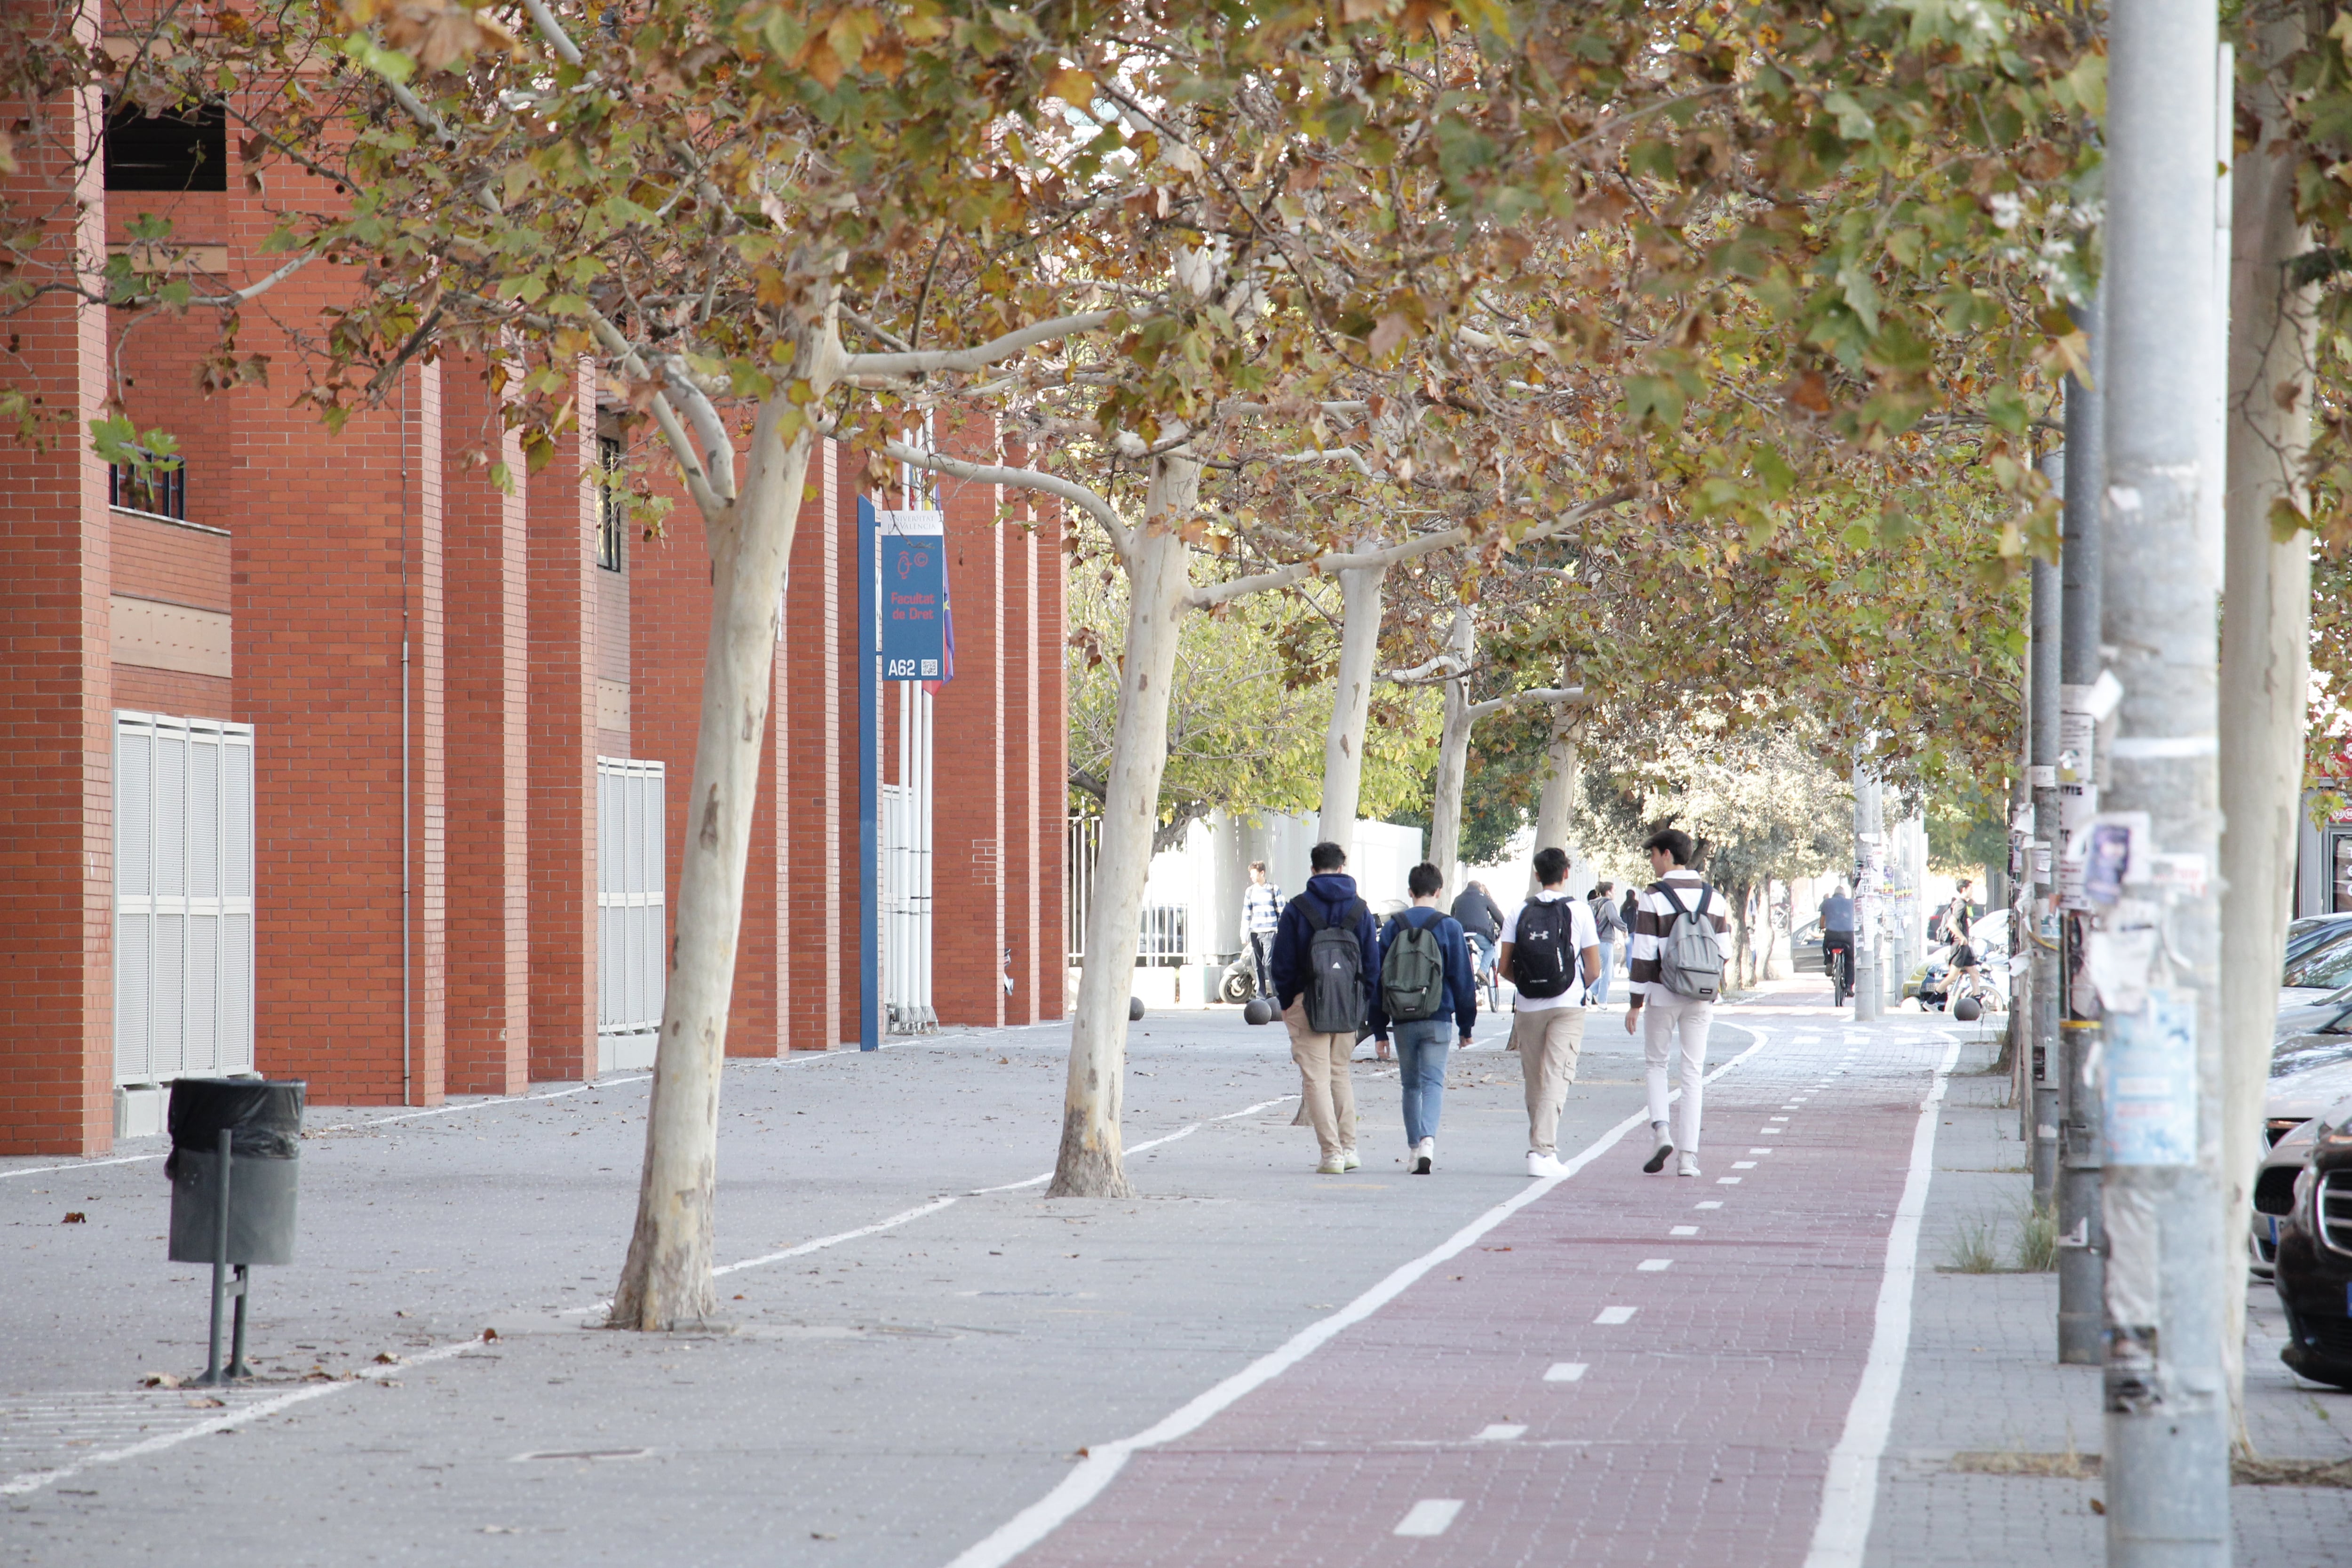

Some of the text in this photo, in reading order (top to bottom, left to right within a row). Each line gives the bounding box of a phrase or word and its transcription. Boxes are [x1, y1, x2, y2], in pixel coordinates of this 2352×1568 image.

[891, 592, 934, 604] Facultat
[892, 607, 934, 619] de Dret
[888, 659, 915, 676] A62
